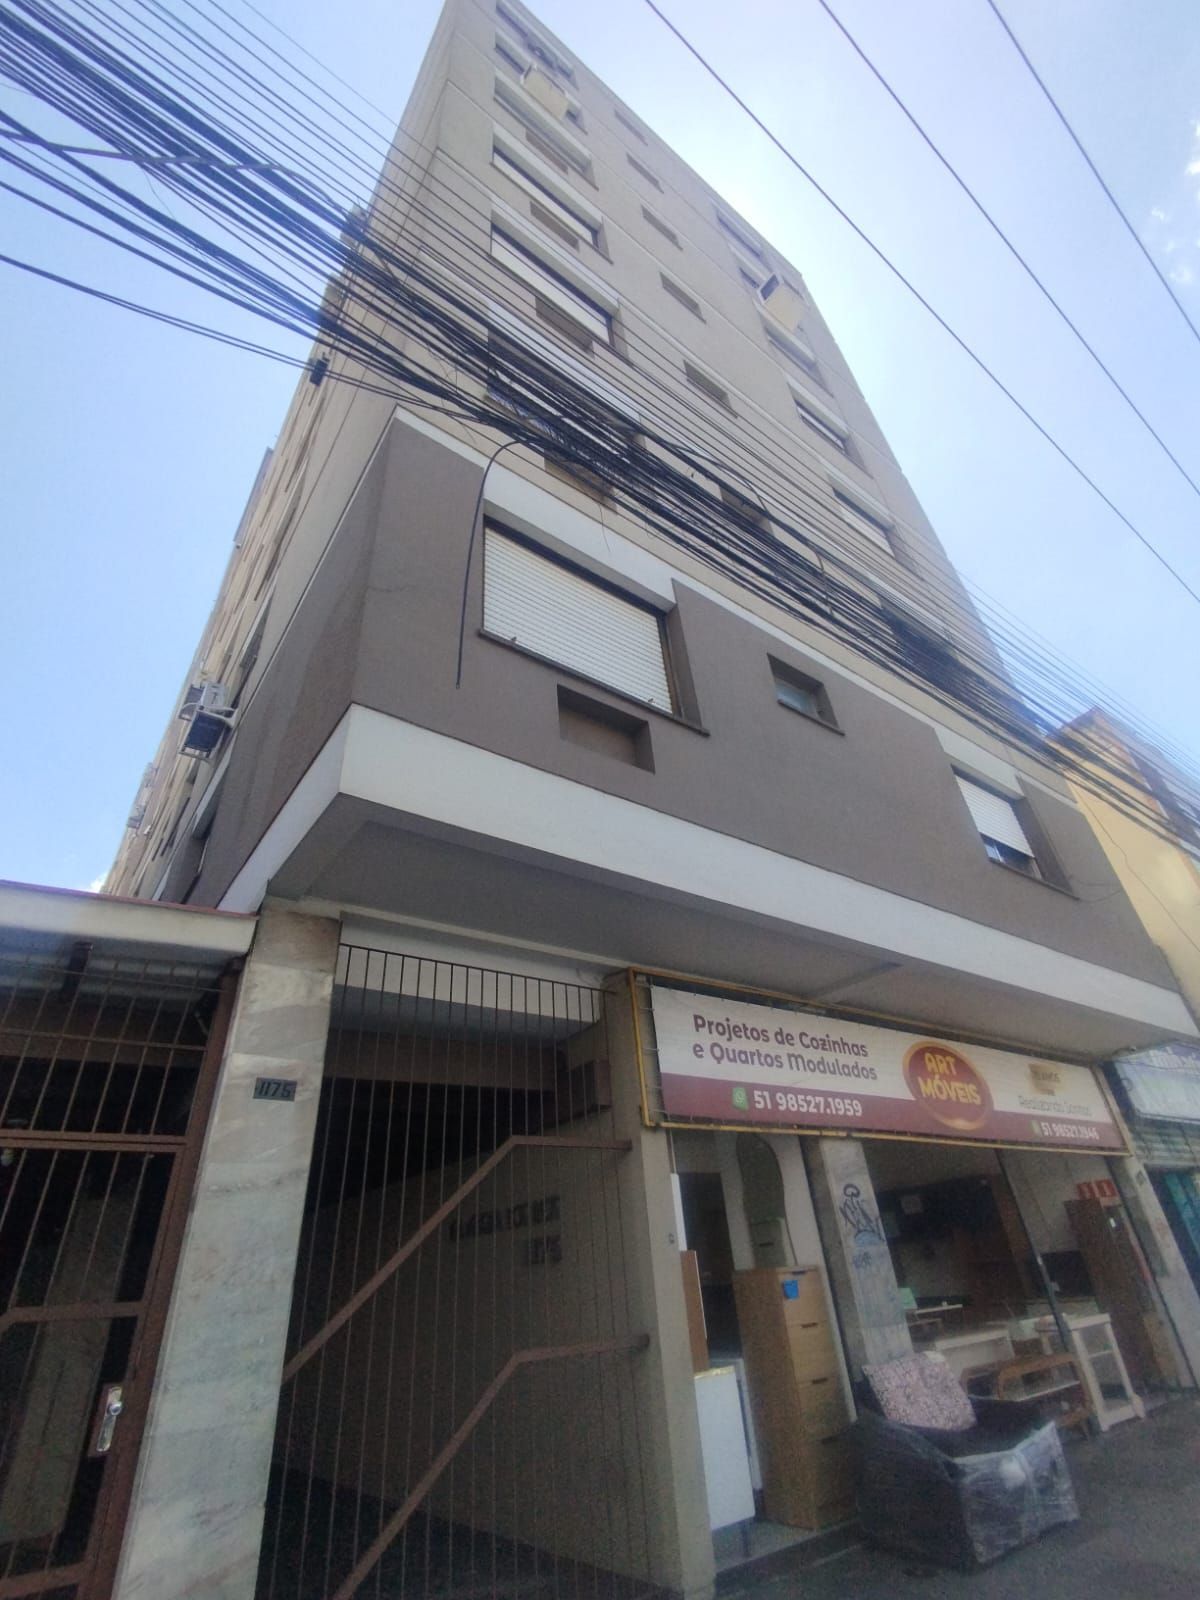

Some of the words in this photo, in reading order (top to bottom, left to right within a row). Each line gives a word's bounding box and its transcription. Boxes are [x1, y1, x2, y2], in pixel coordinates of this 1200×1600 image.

[692, 1014, 770, 1042] Projetos
[774, 1027, 795, 1046] de
[799, 1031, 869, 1057] Cozinhas
[692, 1043, 705, 1059] e
[709, 1042, 784, 1069] Quartos
[787, 1052, 878, 1081] Modulados
[924, 1052, 957, 1076] ART
[753, 1090, 772, 1109] 51
[775, 1092, 863, 1117] 98527.1959
[917, 1074, 982, 1105] MÓVEIS
